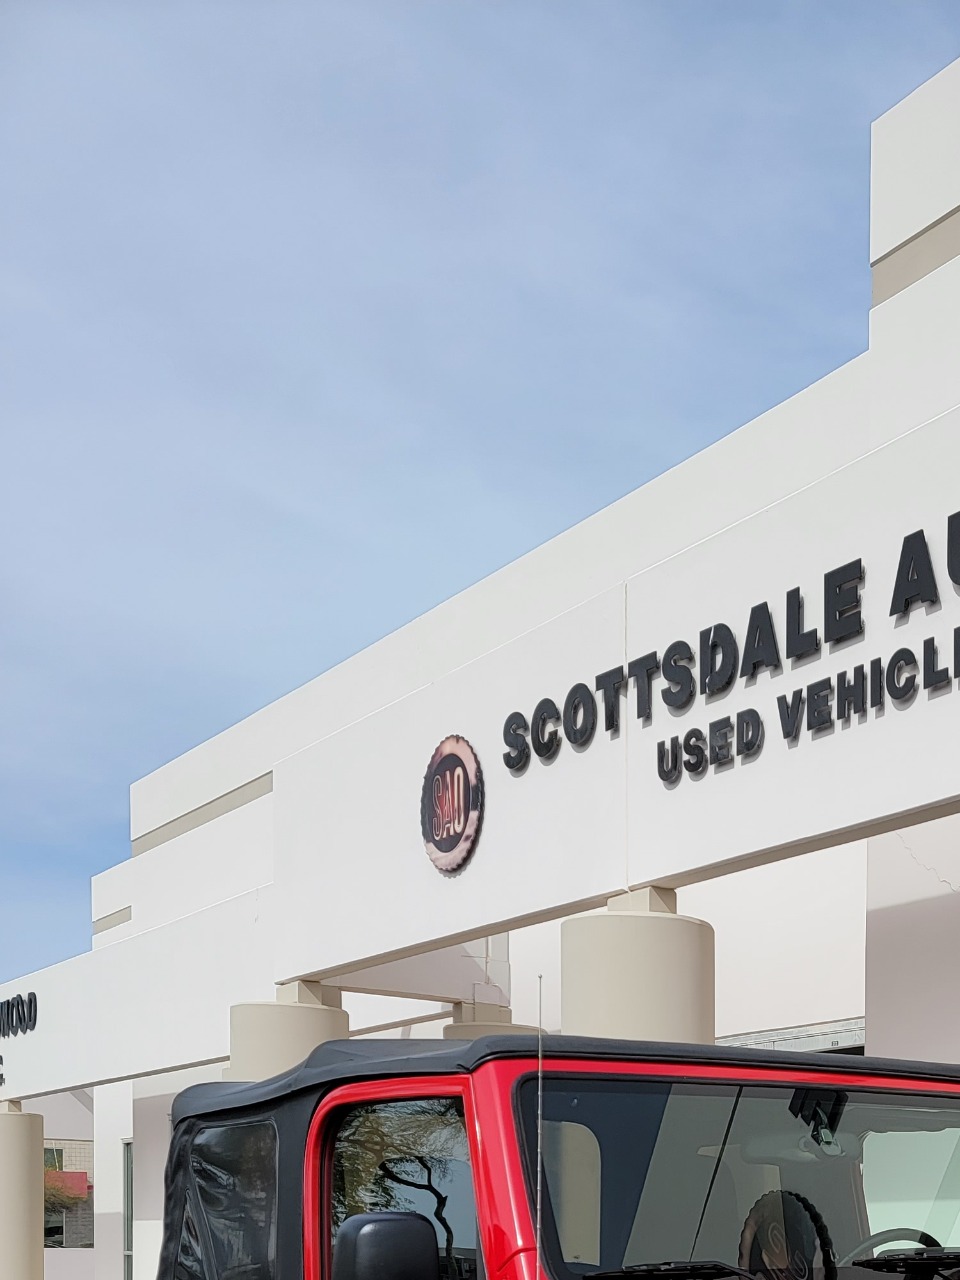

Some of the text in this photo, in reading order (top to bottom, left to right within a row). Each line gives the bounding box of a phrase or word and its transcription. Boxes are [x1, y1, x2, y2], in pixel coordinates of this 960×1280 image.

[502, 558, 864, 770] SCOTTSDALE
[657, 707, 765, 782] USED
[432, 766, 465, 841] SAO
